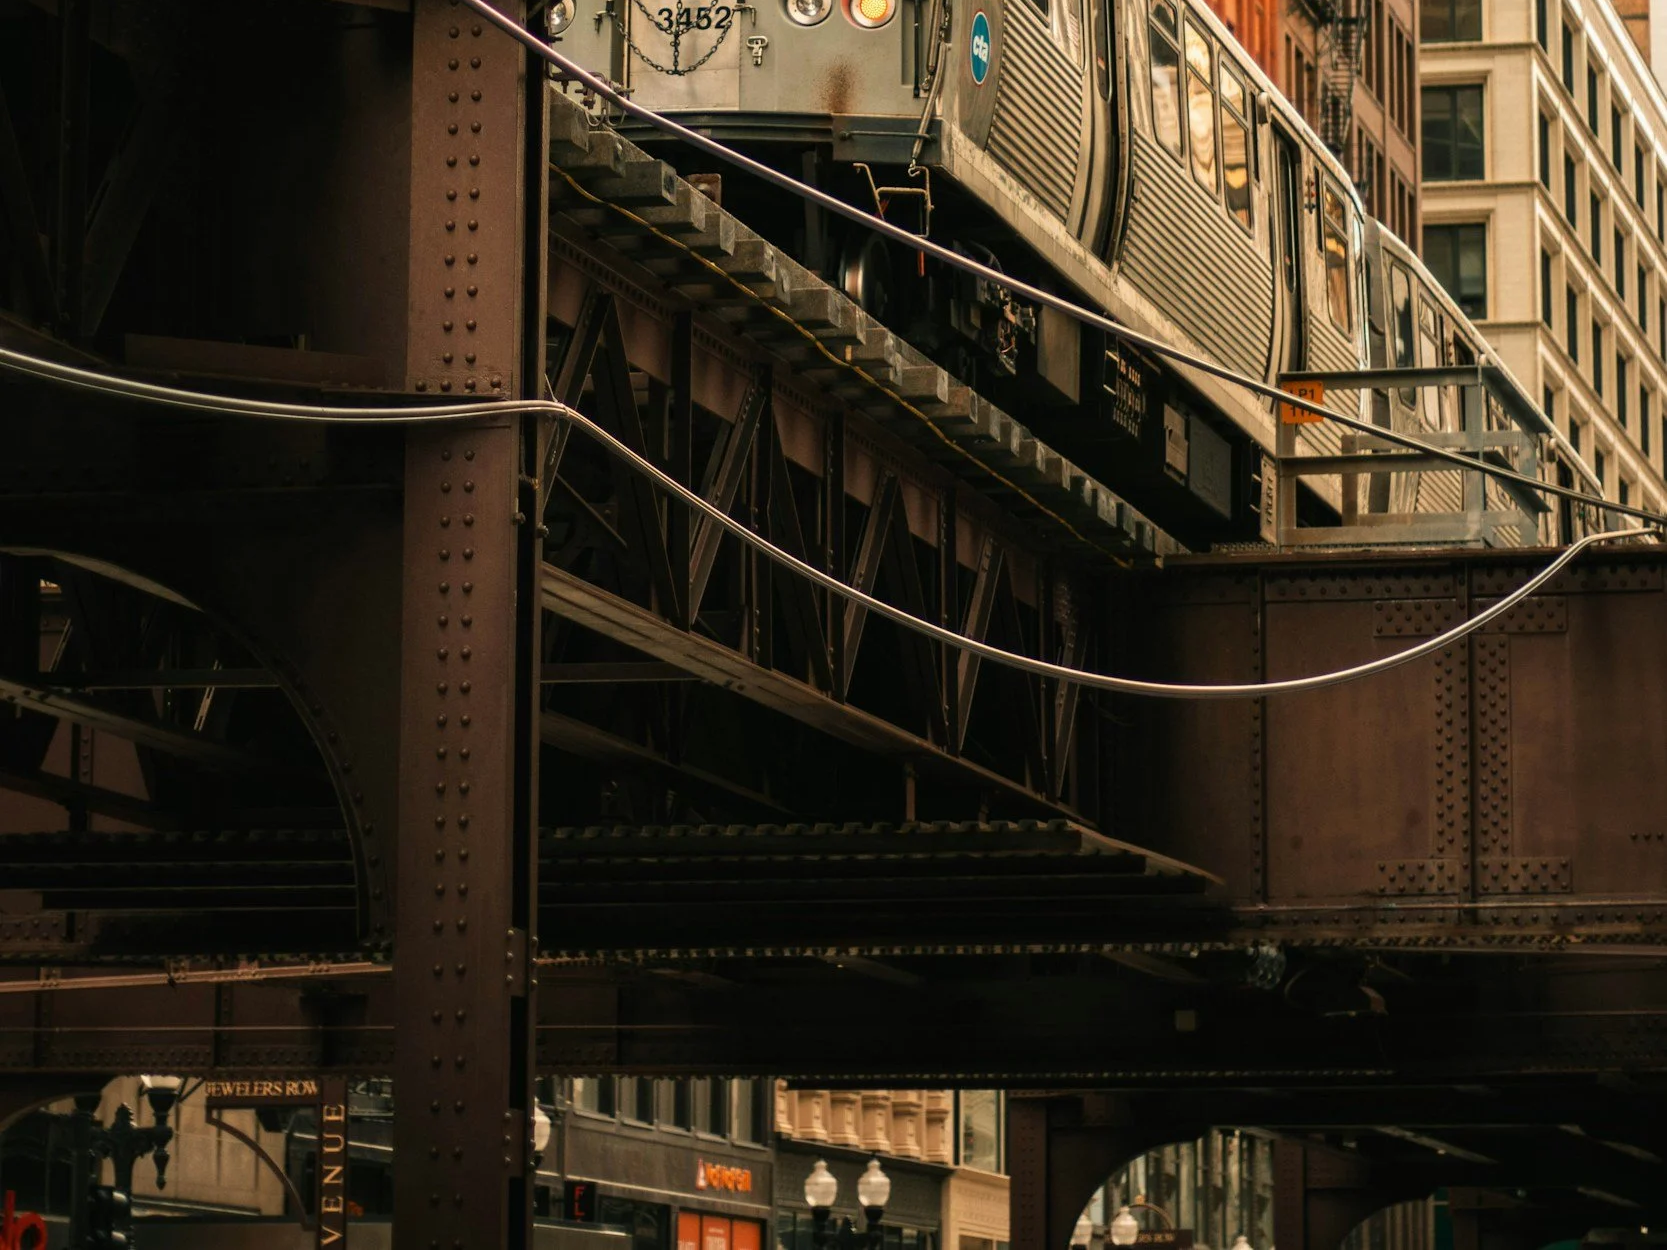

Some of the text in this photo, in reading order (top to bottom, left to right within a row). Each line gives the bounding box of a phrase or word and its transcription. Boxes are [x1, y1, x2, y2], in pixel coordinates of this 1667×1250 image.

[657, 5, 731, 30] 3452
[972, 34, 989, 64] cta
[1289, 388, 1315, 401] P1
[205, 1081, 319, 1097] JEWELERS ROW
